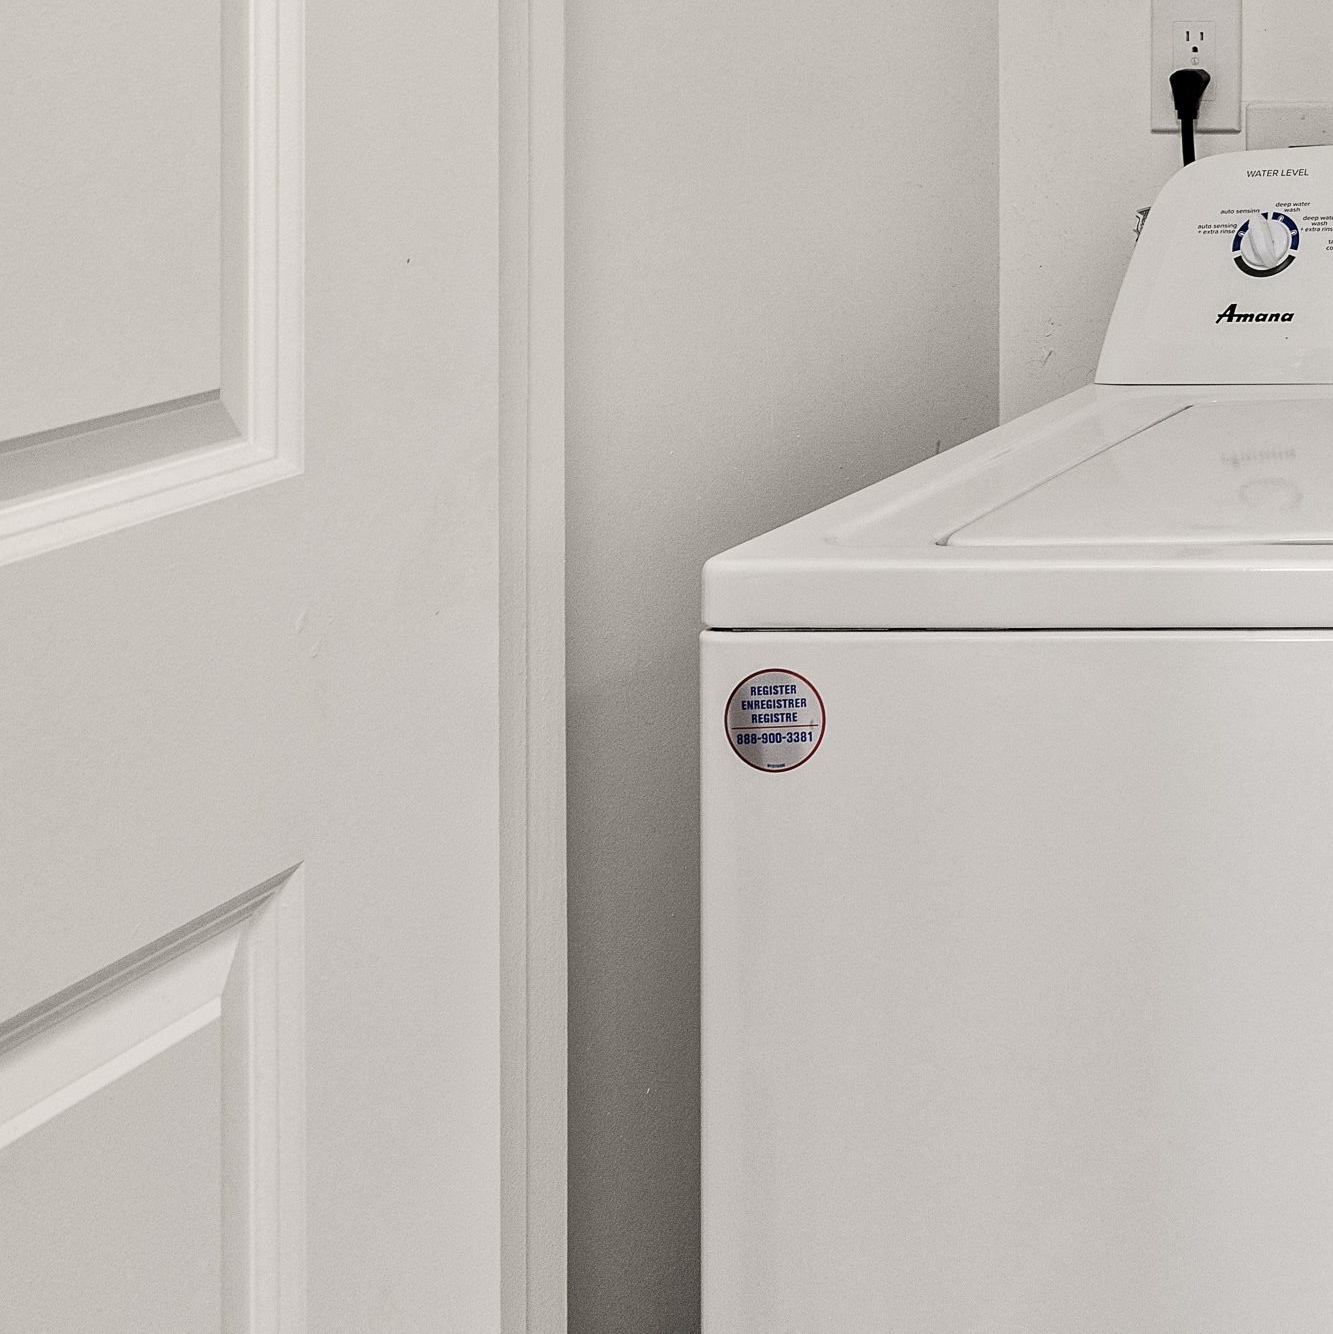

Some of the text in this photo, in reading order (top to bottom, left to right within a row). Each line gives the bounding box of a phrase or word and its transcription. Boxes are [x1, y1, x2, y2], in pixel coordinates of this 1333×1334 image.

[1246, 168, 1309, 178] WATER LEVEL
[1215, 303, 1295, 324] Amana
[750, 685, 797, 696] REGISTER
[741, 698, 807, 710] ENREGISTRER
[751, 712, 798, 724] REGISTRE
[736, 731, 813, 745] 888-900-3381
